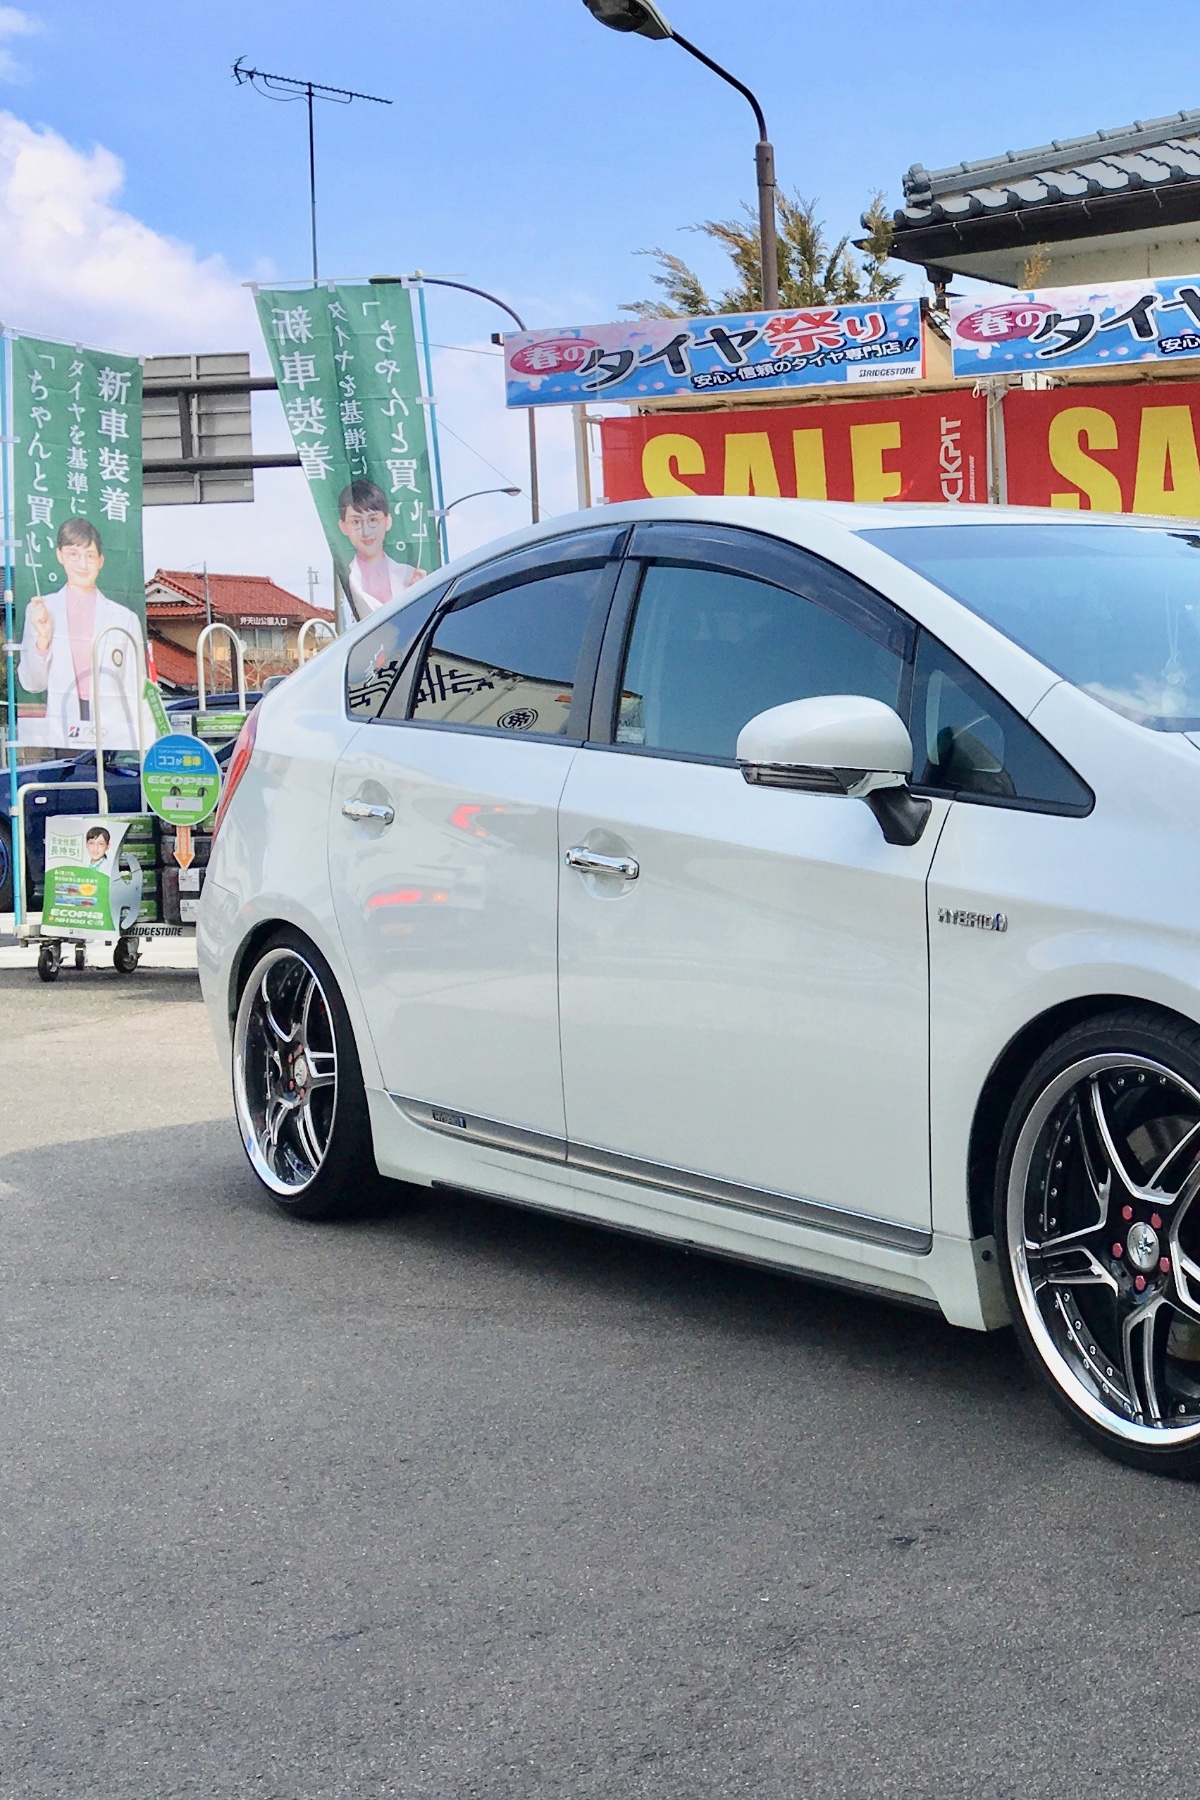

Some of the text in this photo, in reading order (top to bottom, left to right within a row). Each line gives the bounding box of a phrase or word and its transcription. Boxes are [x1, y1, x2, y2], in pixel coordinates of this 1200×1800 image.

[858, 366, 917, 378] BRIDGESTONE
[66, 359, 89, 515] タイヤを基準に
[97, 366, 131, 523] 新車装着
[939, 416, 964, 503] CKPIT
[128, 926, 183, 936] RIDGESTONE
